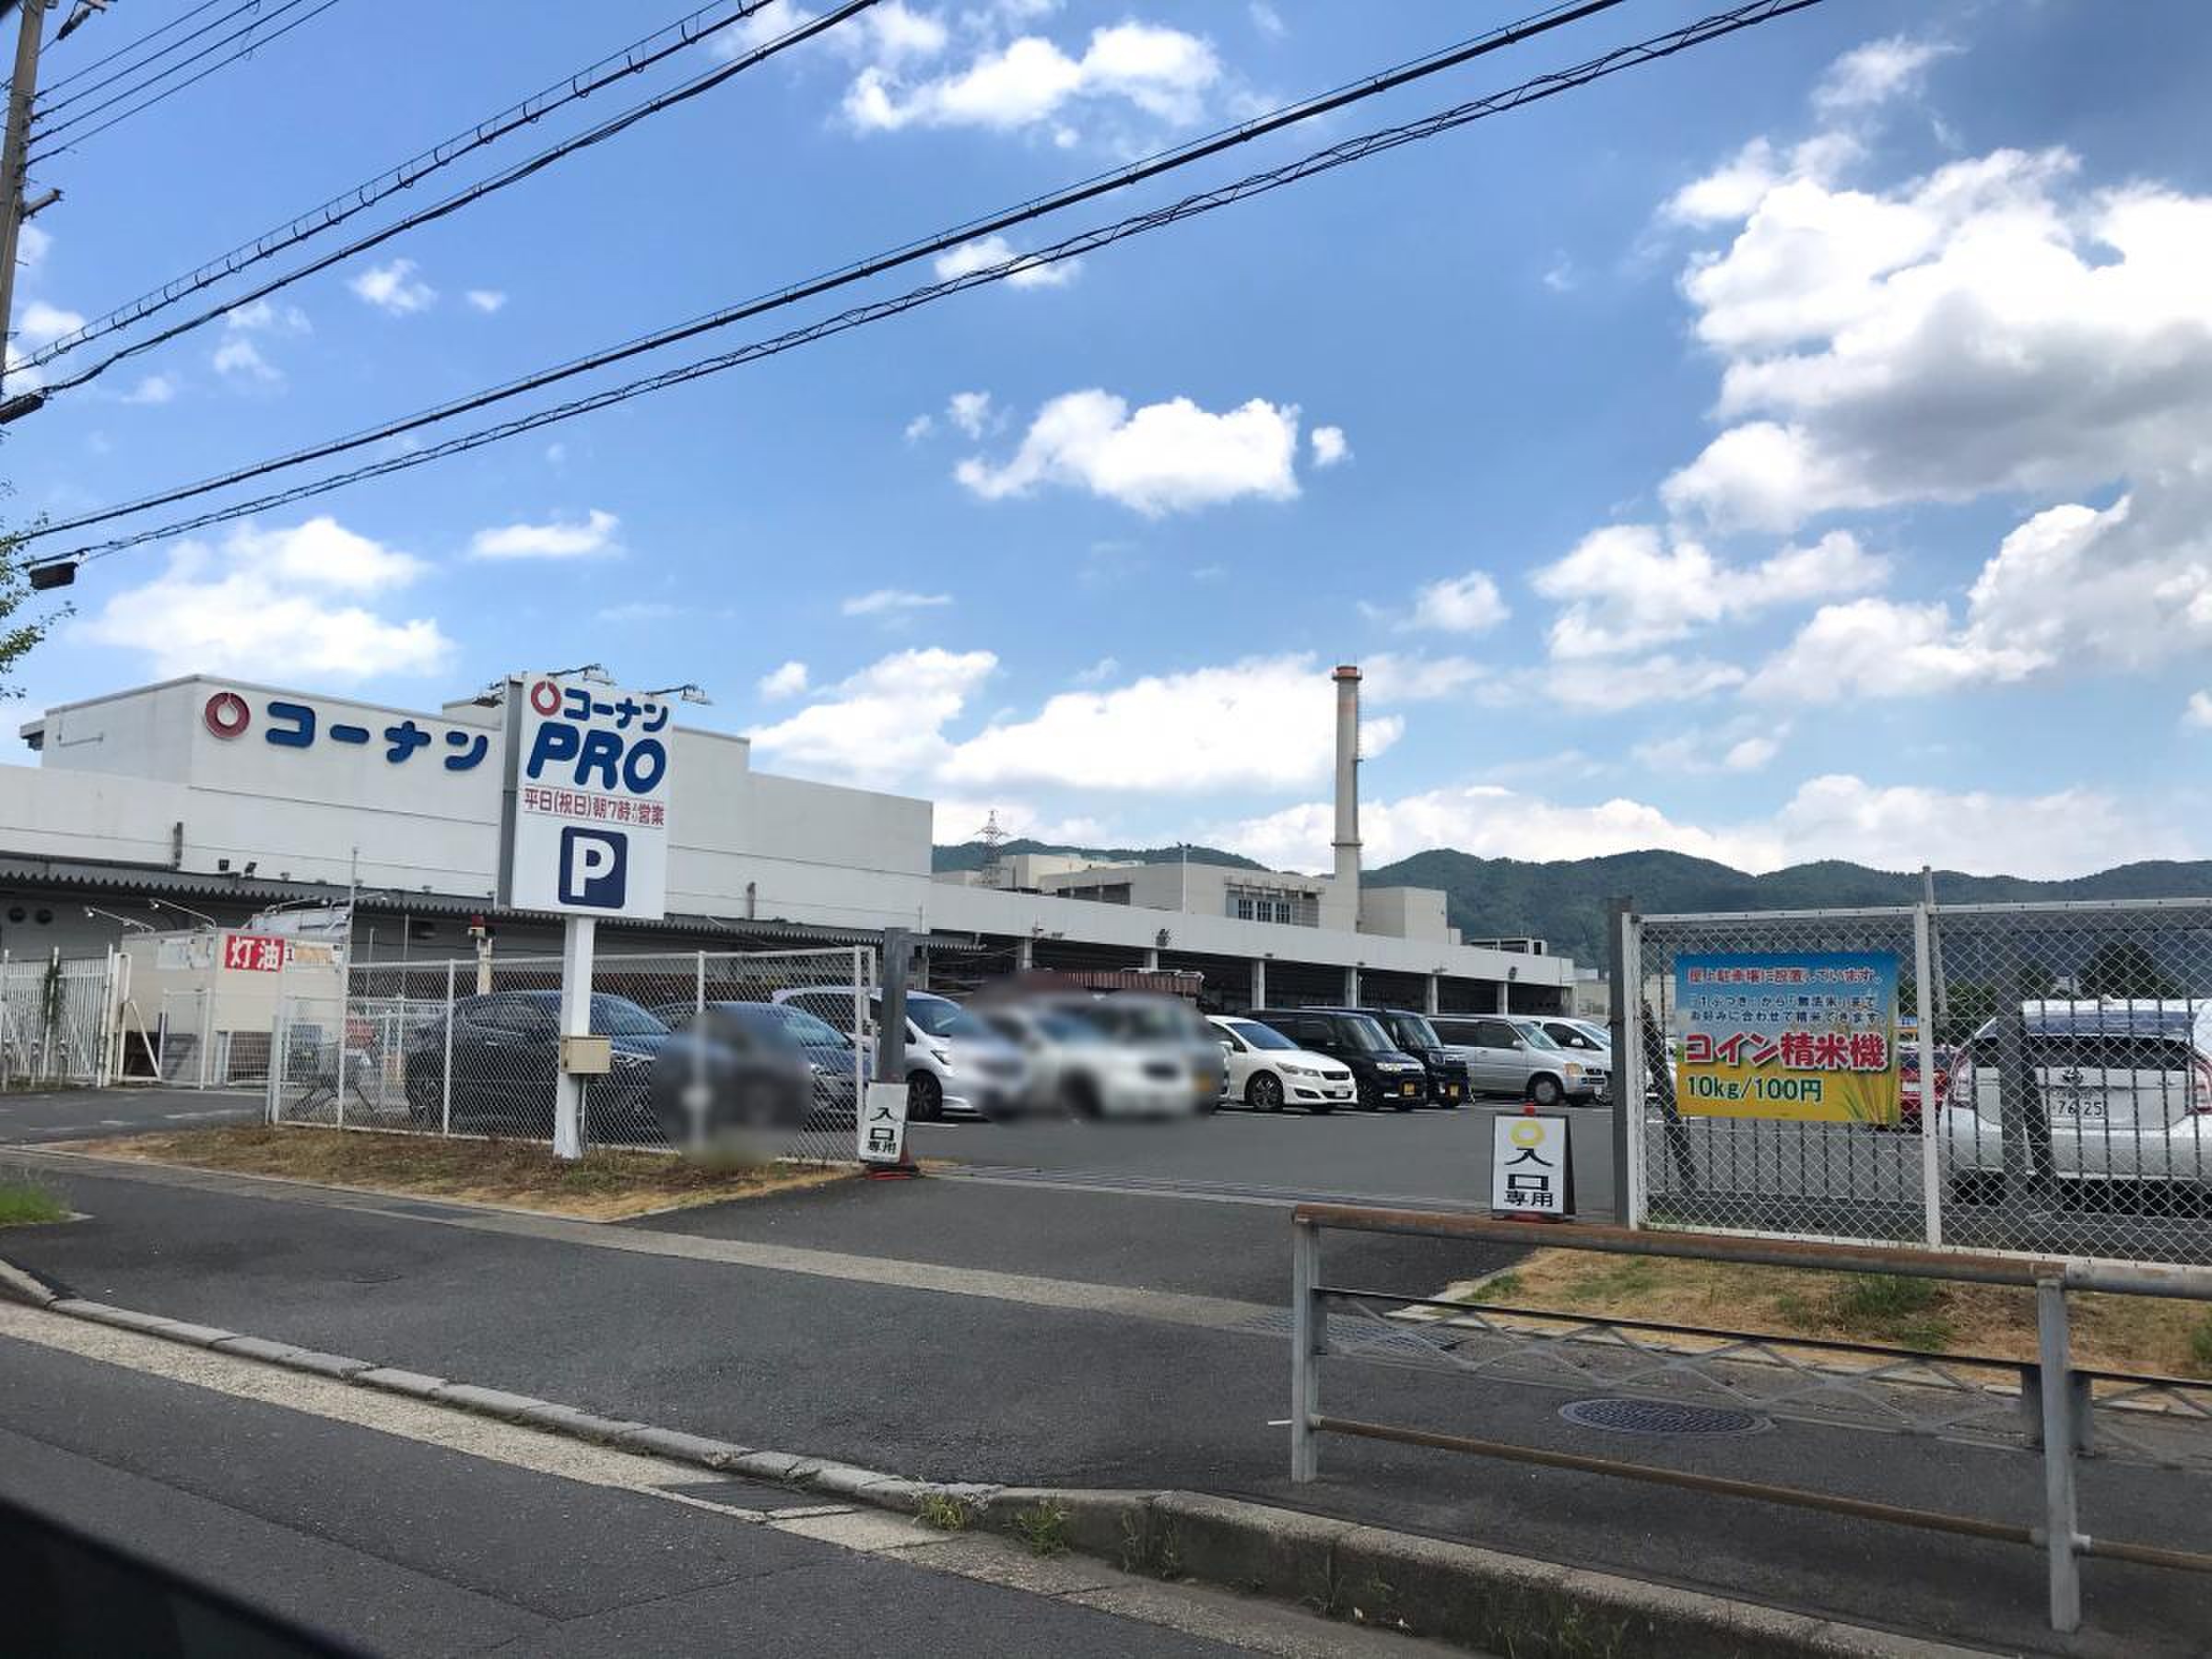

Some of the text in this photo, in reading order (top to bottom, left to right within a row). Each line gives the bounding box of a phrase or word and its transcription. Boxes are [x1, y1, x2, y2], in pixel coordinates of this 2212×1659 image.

[563, 688, 668, 732] コーナン
[265, 701, 488, 771] コーナン
[526, 721, 666, 794] PRO
[571, 835, 616, 897] P
[230, 936, 280, 971] 灯油
[1686, 1031, 1888, 1070] コイン精米機
[1688, 1076, 1824, 1102] 10kg/100円
[869, 1106, 898, 1141] 入口
[1504, 1147, 1554, 1191] 入口
[1504, 1190, 1553, 1206] 専用
